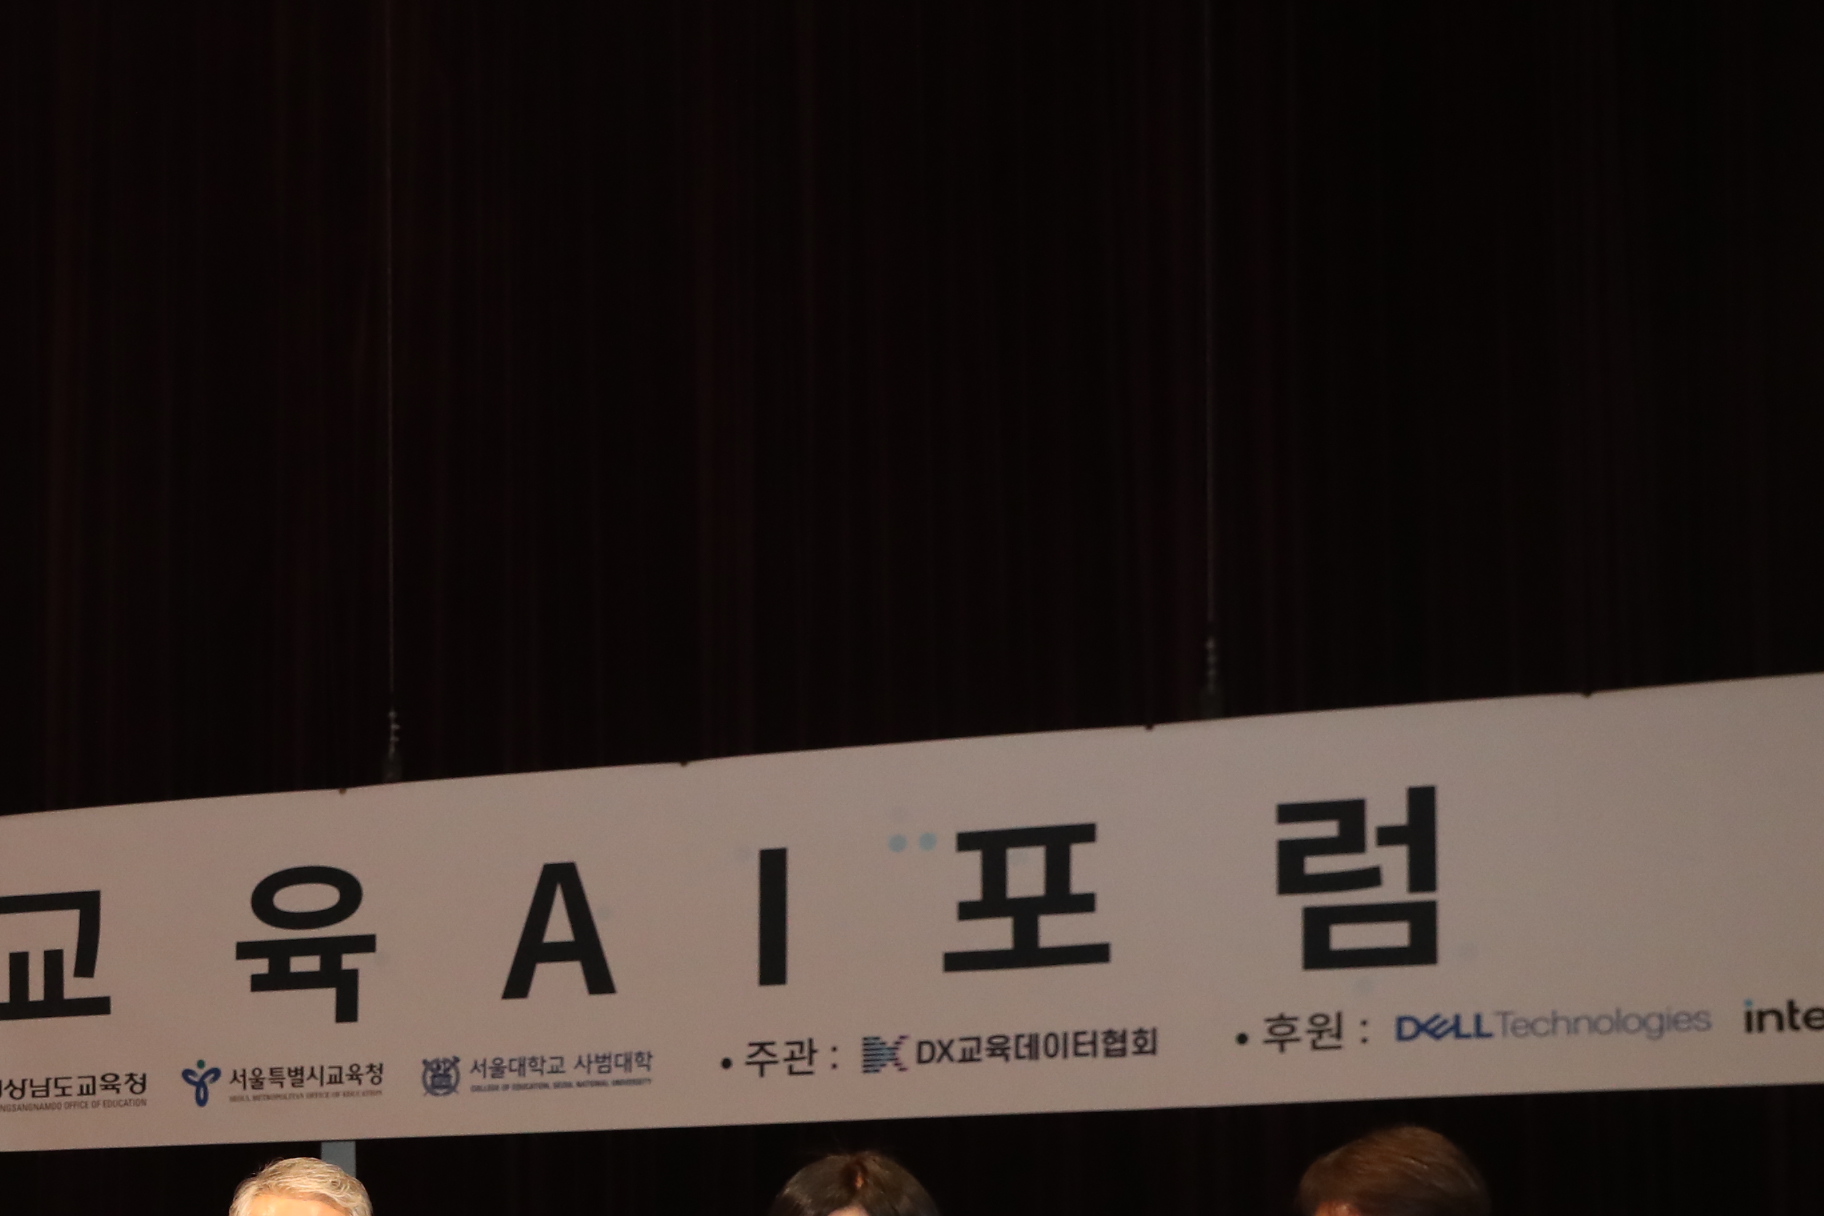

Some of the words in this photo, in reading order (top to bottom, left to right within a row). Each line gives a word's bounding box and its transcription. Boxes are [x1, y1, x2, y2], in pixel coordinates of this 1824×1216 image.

[1395, 1013, 1493, 1042] DELL
[1494, 1006, 1712, 1040] Technologies
[916, 1027, 1157, 1065] DX교육데이터협회
[229, 1063, 384, 1091] 서울특별시교육청
[470, 1055, 566, 1079] 서울대학교
[574, 1051, 653, 1075] 사범대학
[65, 1101, 88, 1111] OFFICE
[91, 1100, 100, 1109] OF
[103, 1098, 147, 1108] EDUCATION
